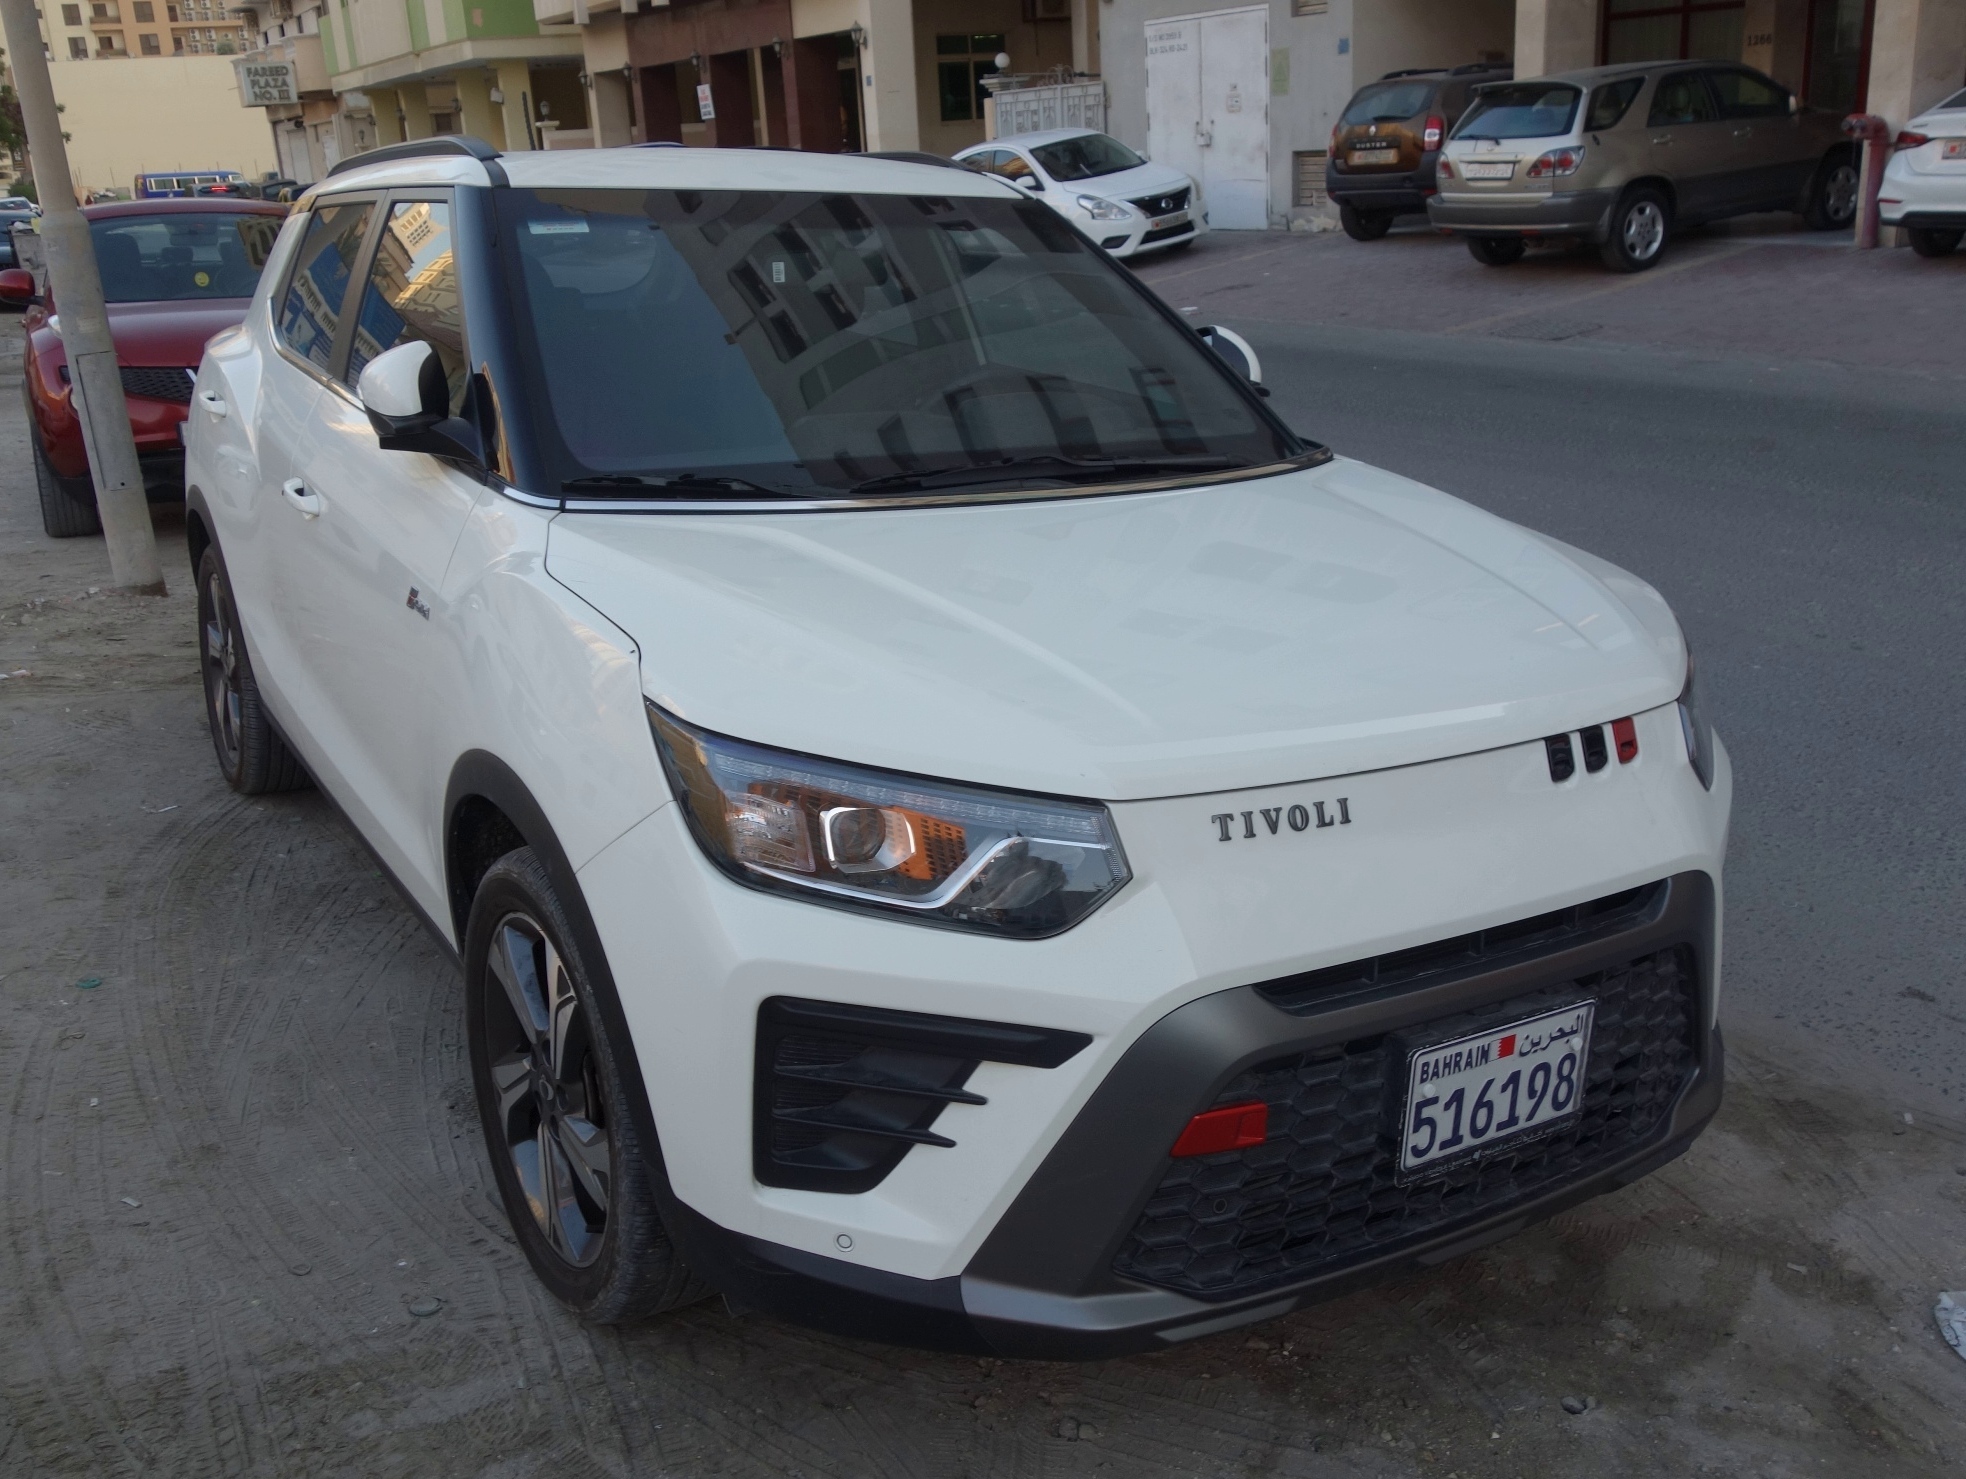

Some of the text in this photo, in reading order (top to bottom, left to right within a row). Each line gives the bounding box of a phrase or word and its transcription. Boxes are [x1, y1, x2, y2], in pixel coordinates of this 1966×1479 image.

[246, 65, 289, 78] FAREED
[250, 77, 290, 90] PLAZA
[1356, 141, 1387, 149] DUSTER
[1211, 797, 1352, 842] TIVOLI
[1519, 1013, 1585, 1058] البحرين
[1419, 1042, 1491, 1085] BAHRAIN
[1410, 1052, 1577, 1159] 516198
